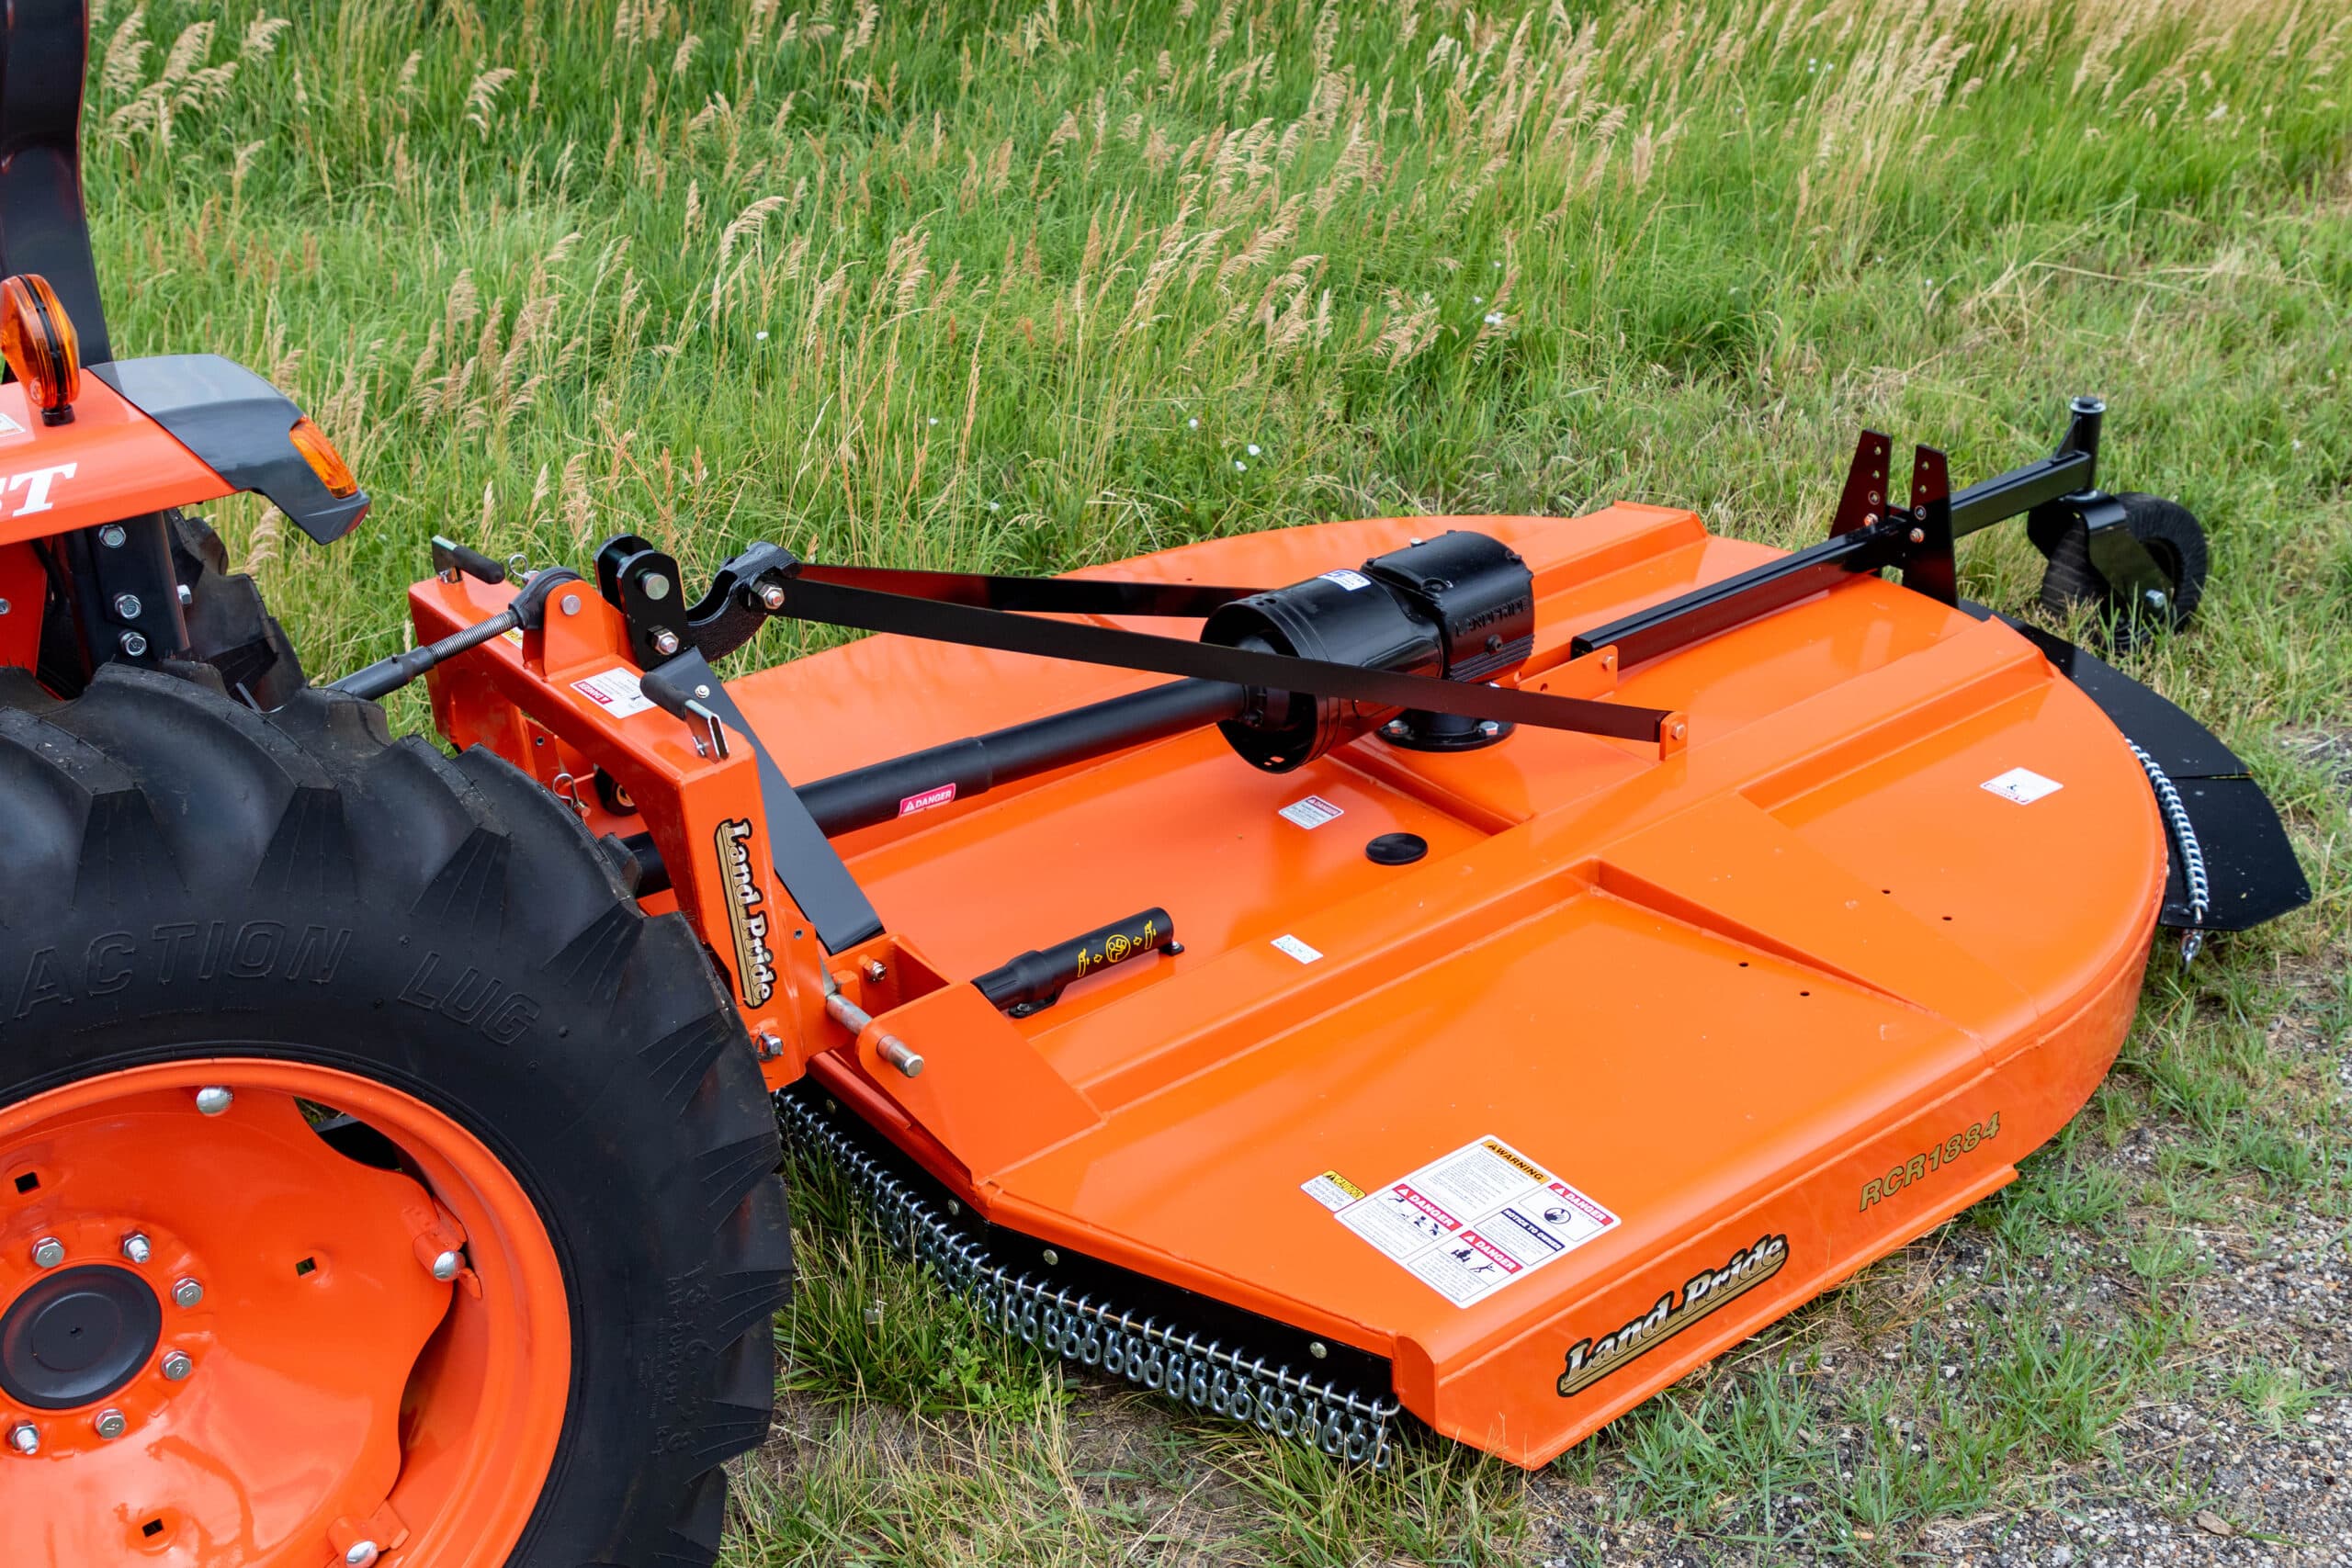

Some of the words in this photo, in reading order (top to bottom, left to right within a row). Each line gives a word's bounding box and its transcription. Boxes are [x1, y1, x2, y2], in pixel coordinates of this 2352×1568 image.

[0, 462, 77, 518] T
[915, 790, 952, 808] DANGER
[724, 819, 762, 907] Land
[13, 919, 354, 1019] ACTION
[398, 950, 541, 1045] LUG
[741, 912, 776, 1004] Pride
[1497, 1147, 1544, 1181] WARNING
[1860, 1111, 2000, 1213] RCR1884
[1408, 1192, 1455, 1227] DANGER
[1565, 1192, 1607, 1221] DANGER
[1474, 1240, 1517, 1270] DANGER
[1565, 1293, 1672, 1384] Land
[1679, 1237, 1786, 1317] Pride
